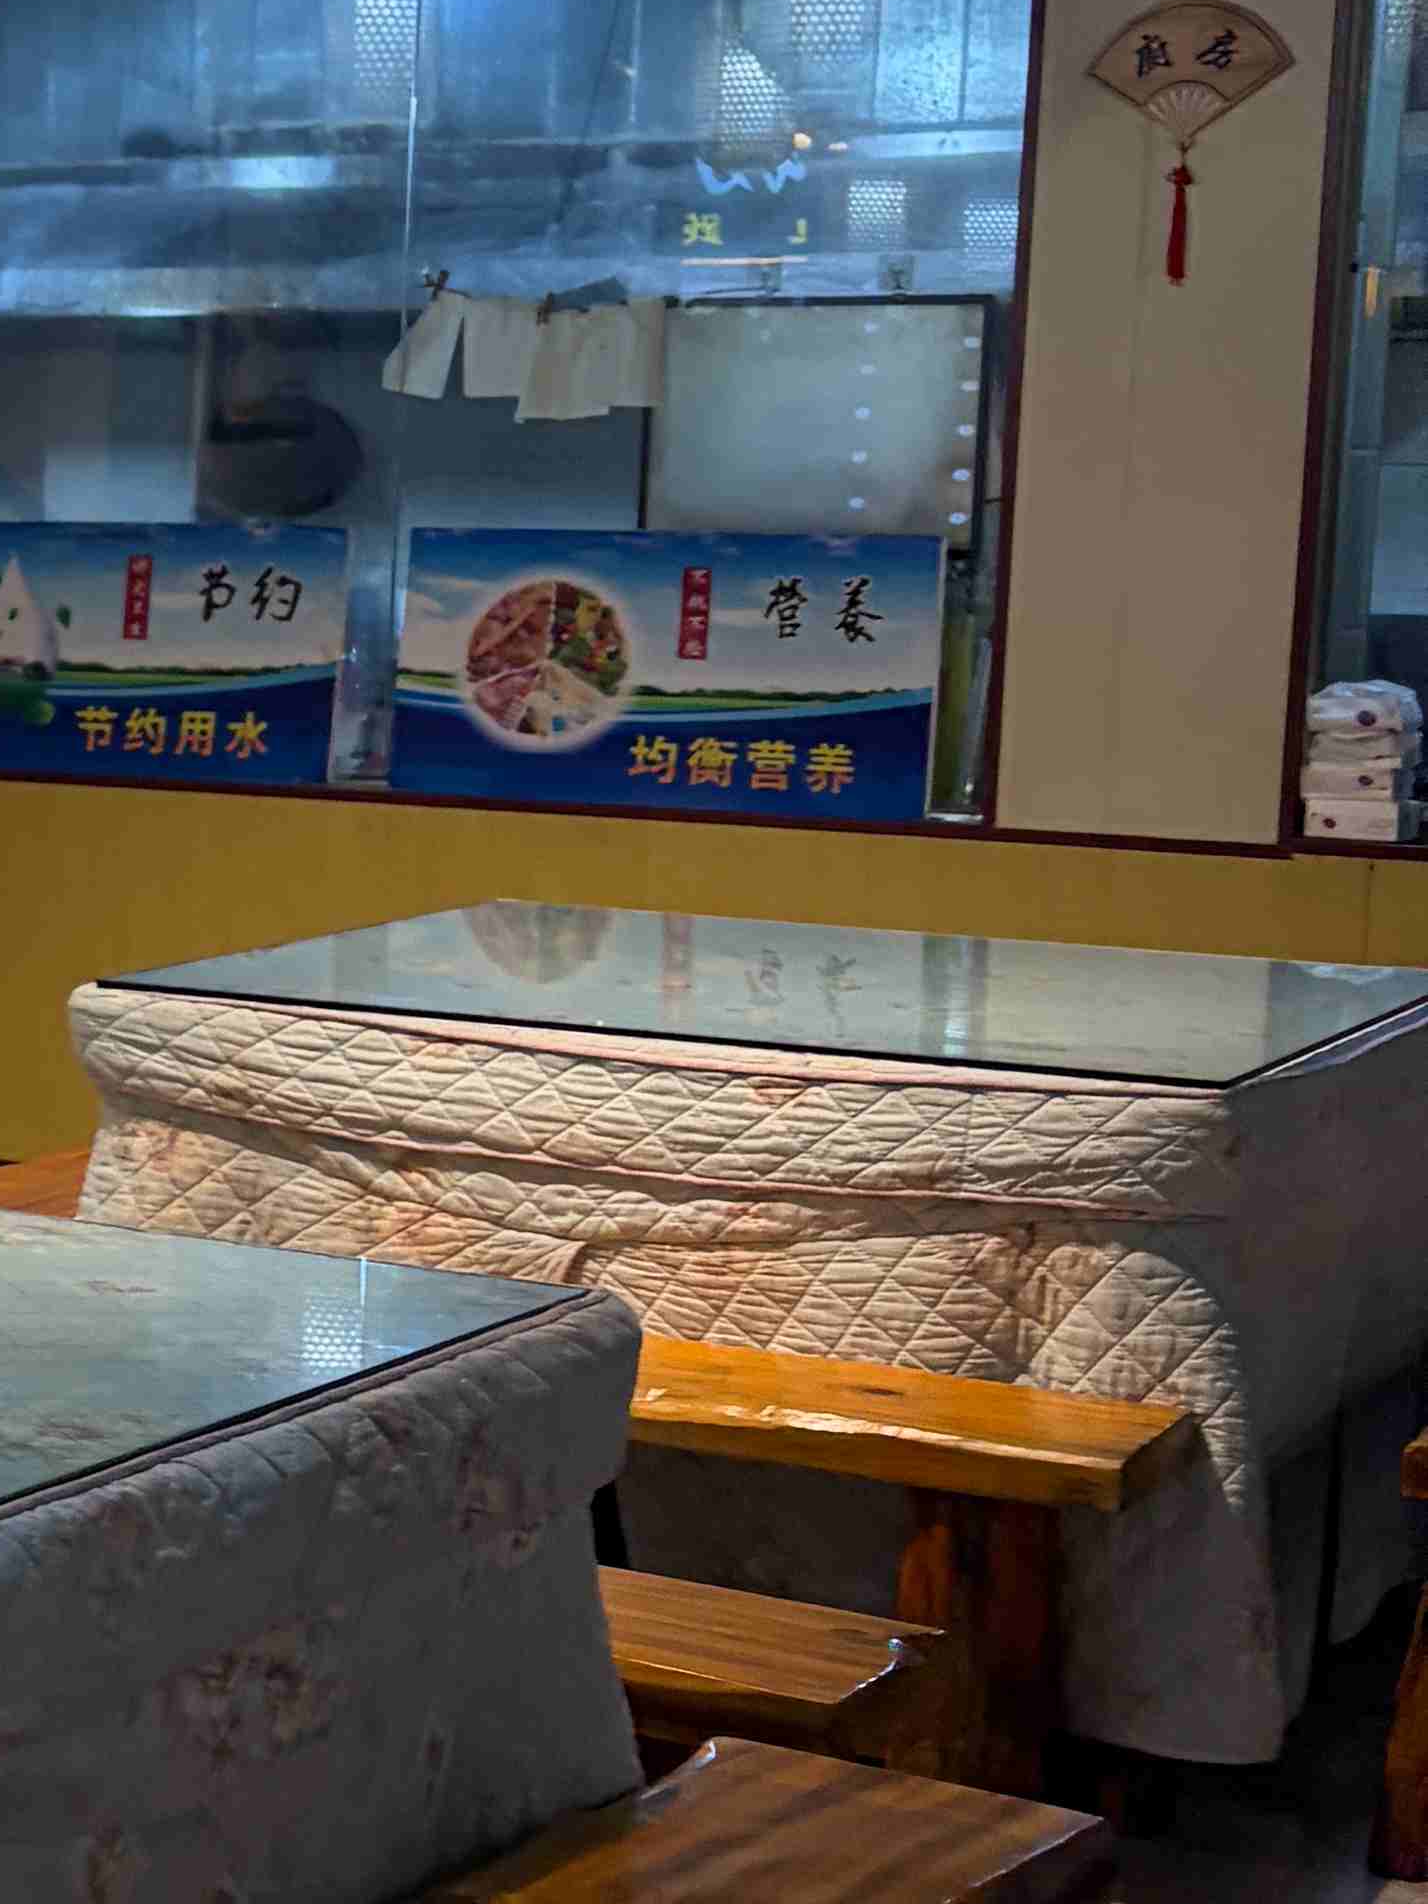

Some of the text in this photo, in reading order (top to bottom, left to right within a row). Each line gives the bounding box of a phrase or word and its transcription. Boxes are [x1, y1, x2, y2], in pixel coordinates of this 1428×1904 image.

[200, 565, 303, 622] 节约
[73, 705, 269, 759] 节约用水
[626, 735, 856, 794] 均衡营养
